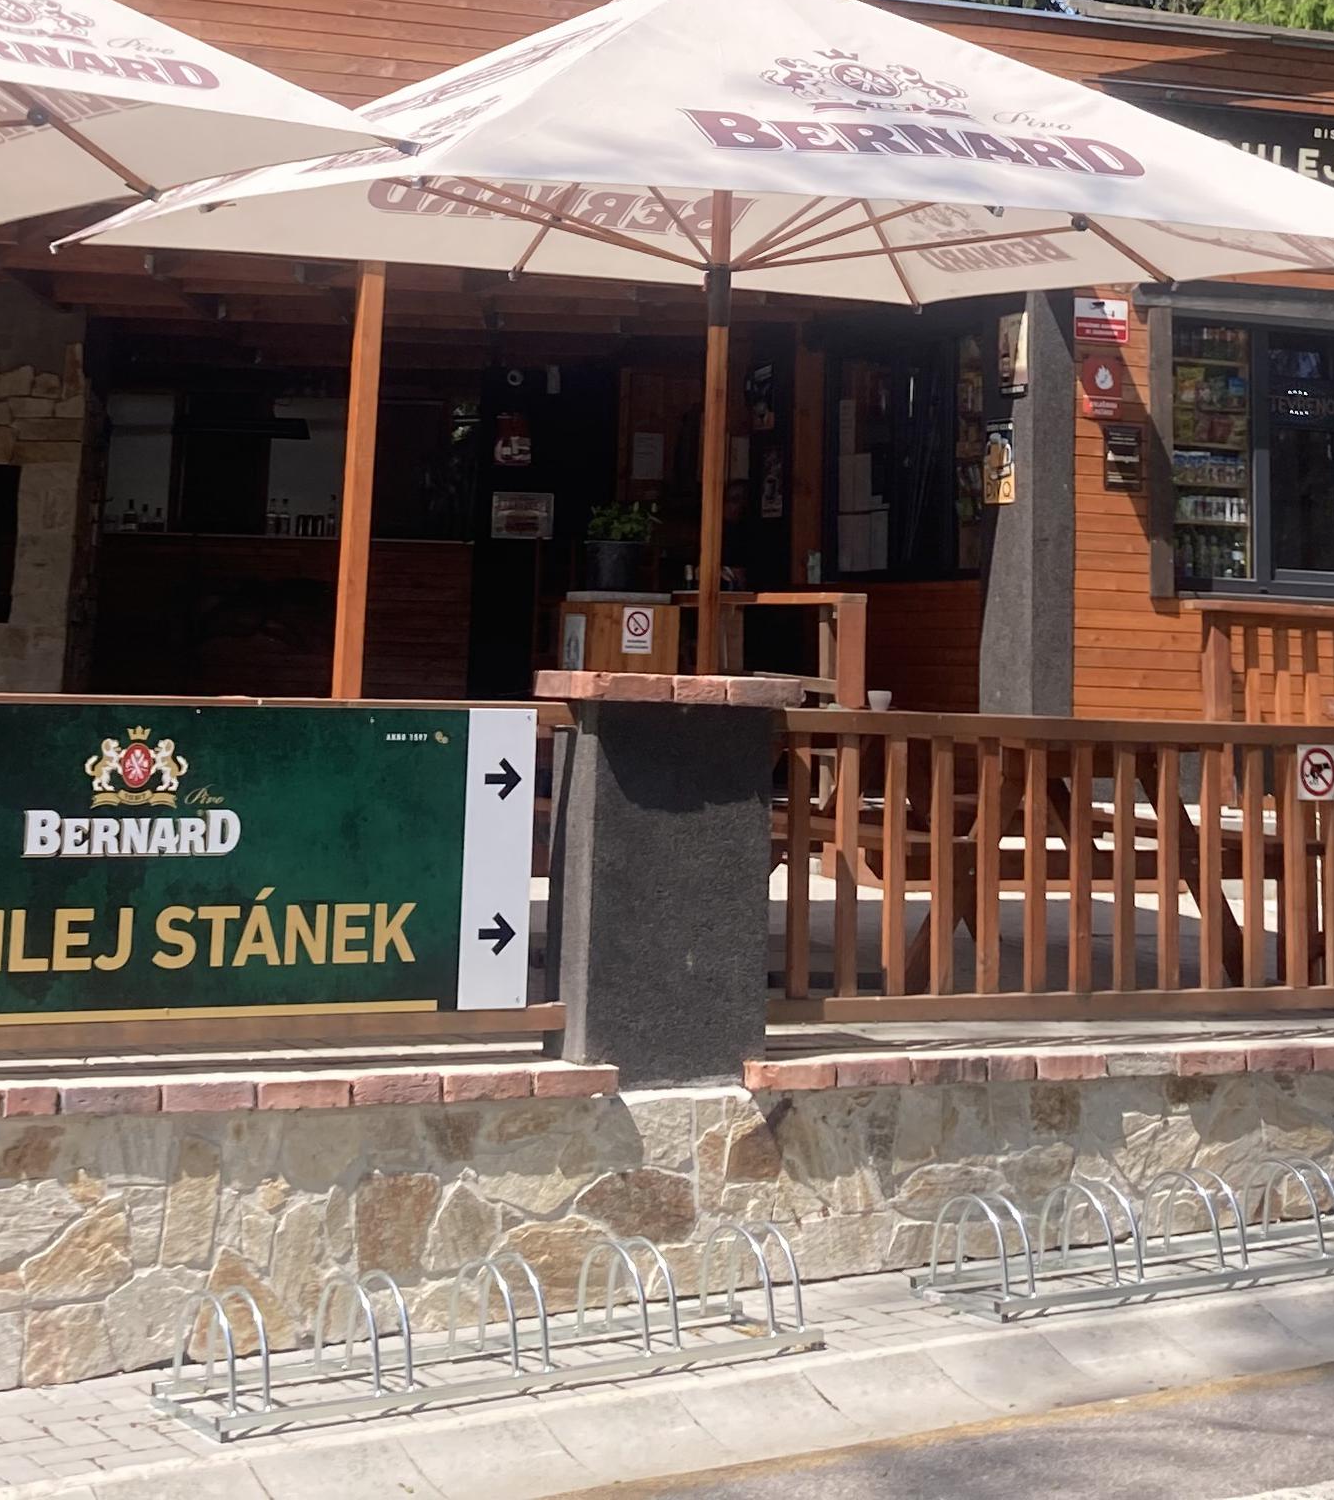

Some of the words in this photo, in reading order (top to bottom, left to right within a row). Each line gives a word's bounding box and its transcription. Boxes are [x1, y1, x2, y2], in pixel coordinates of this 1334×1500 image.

[106, 35, 175, 56] Pivo
[993, 108, 1072, 133] Pivo
[676, 107, 1145, 179] BERNARD
[184, 783, 225, 805] Pivo
[21, 809, 241, 858] BERNARD
[151, 887, 417, 970] STÁNEK
